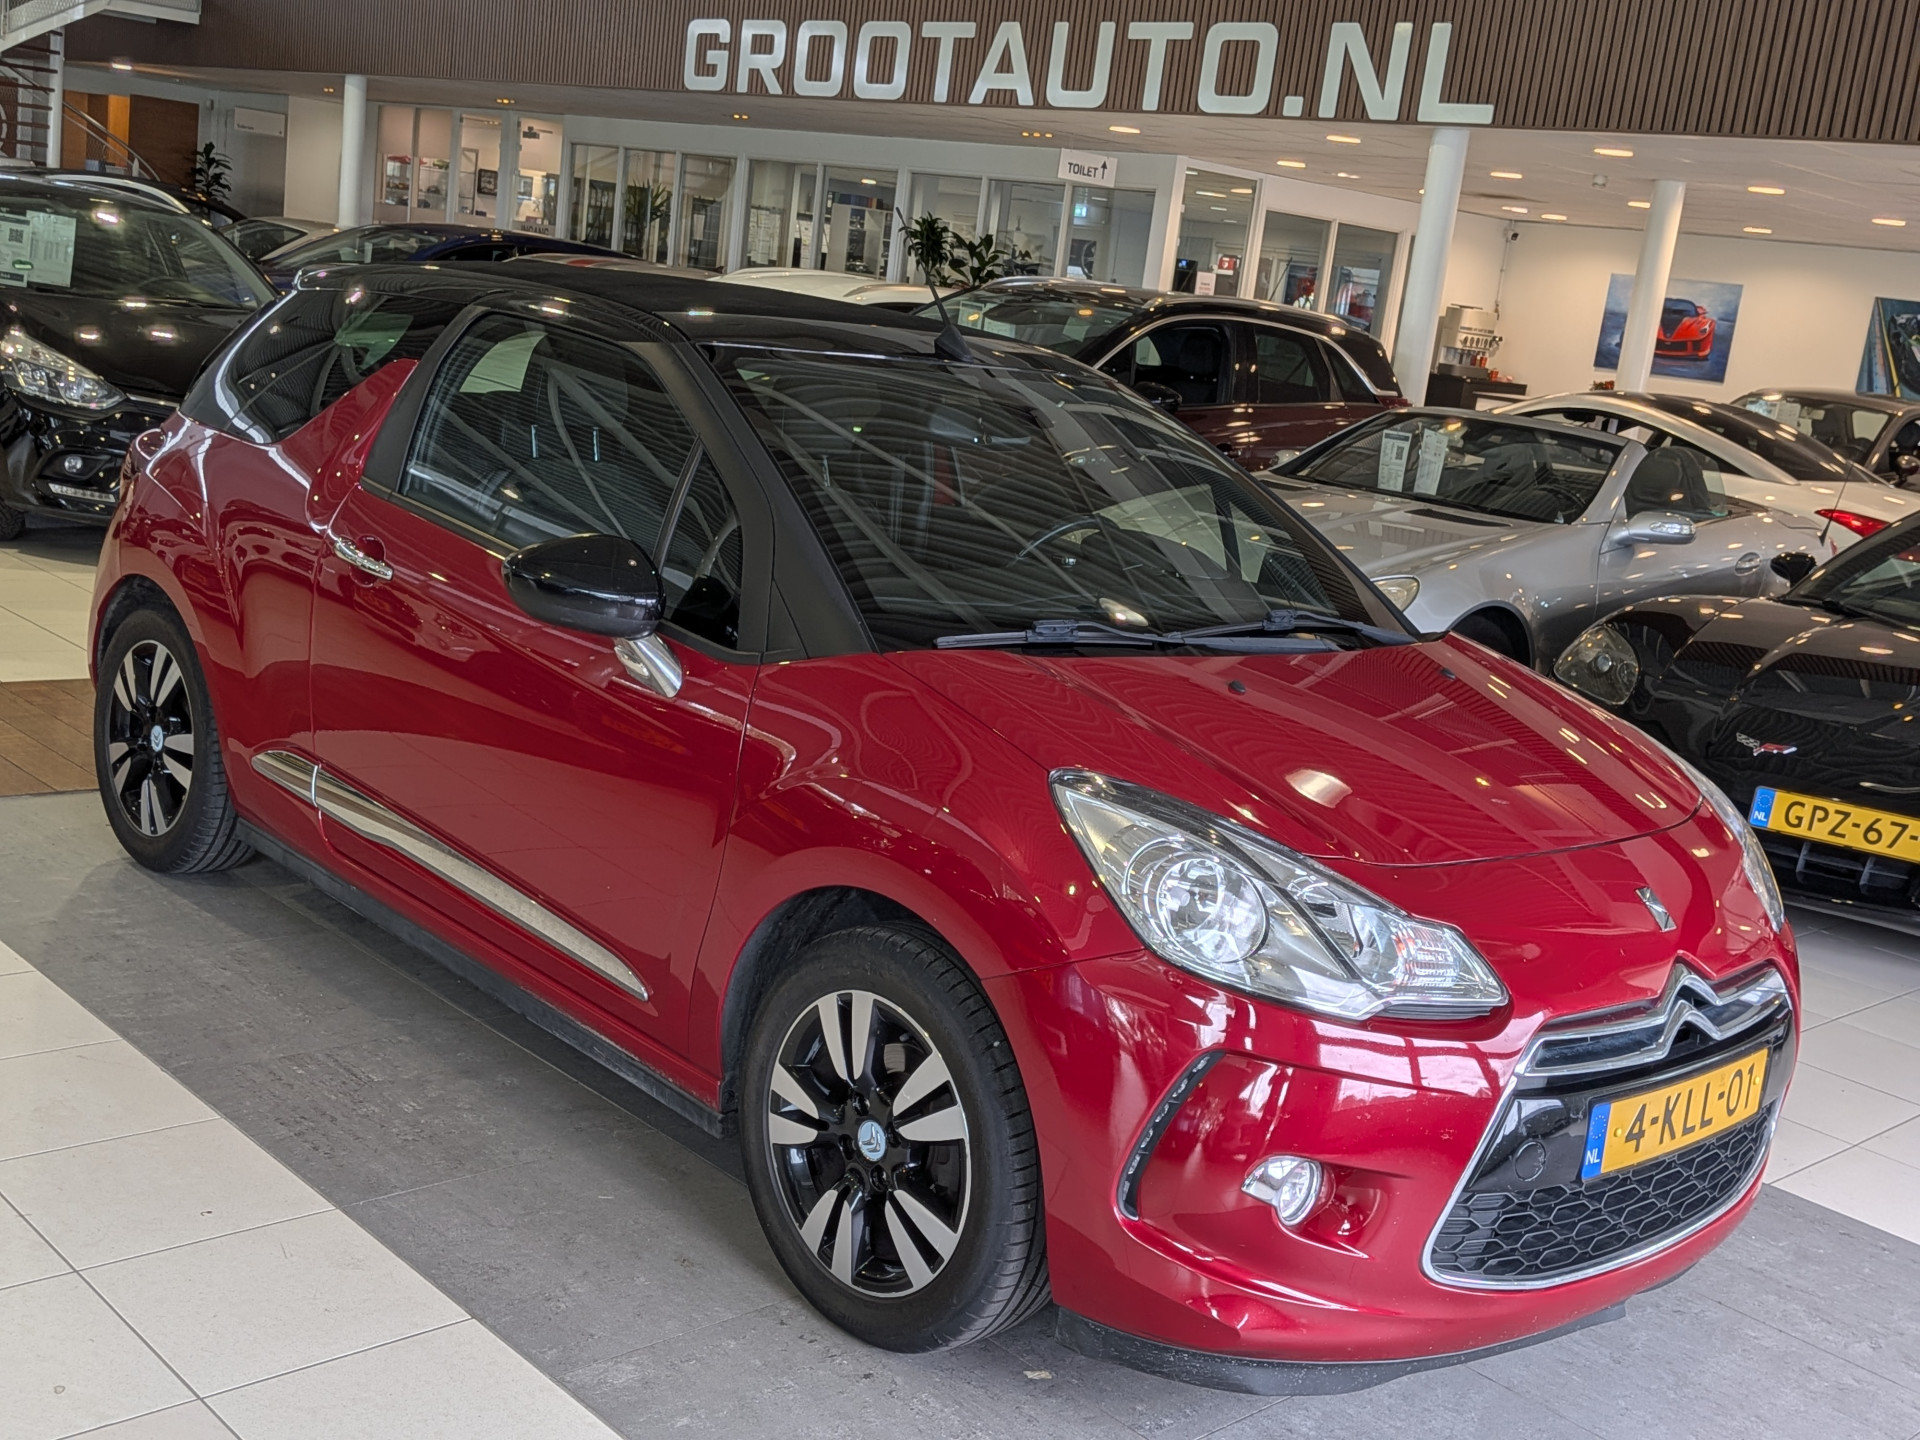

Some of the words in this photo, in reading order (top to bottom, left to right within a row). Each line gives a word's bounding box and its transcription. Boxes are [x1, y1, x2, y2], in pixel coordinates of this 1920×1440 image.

[684, 18, 1494, 124] GROOTAUTO.NL
[1067, 161, 1099, 178] TOILET
[1753, 810, 1767, 821] NL
[1624, 1062, 1756, 1153] 4-KLL-01
[1585, 1147, 1600, 1165] NL
